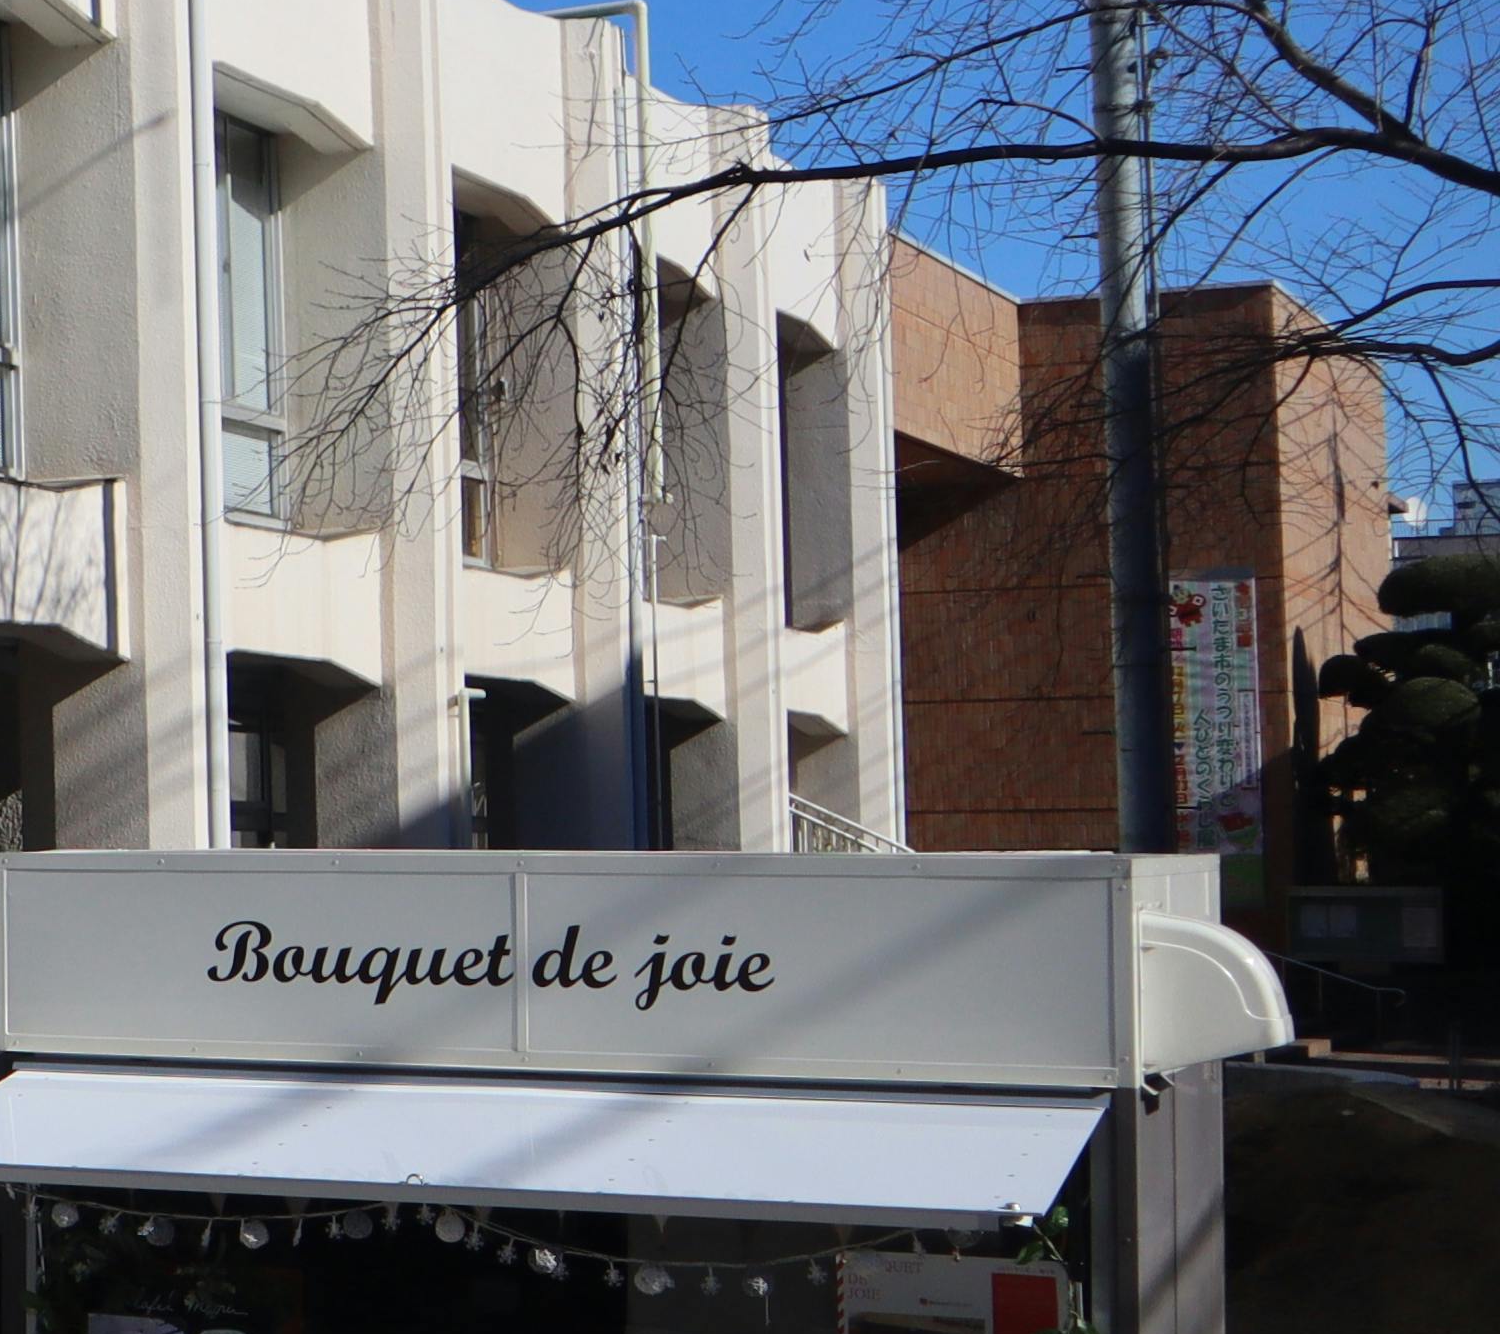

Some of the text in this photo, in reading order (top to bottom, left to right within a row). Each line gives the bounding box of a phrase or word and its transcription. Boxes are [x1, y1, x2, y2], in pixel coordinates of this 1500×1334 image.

[206, 920, 776, 1011] Bouquet de joie
